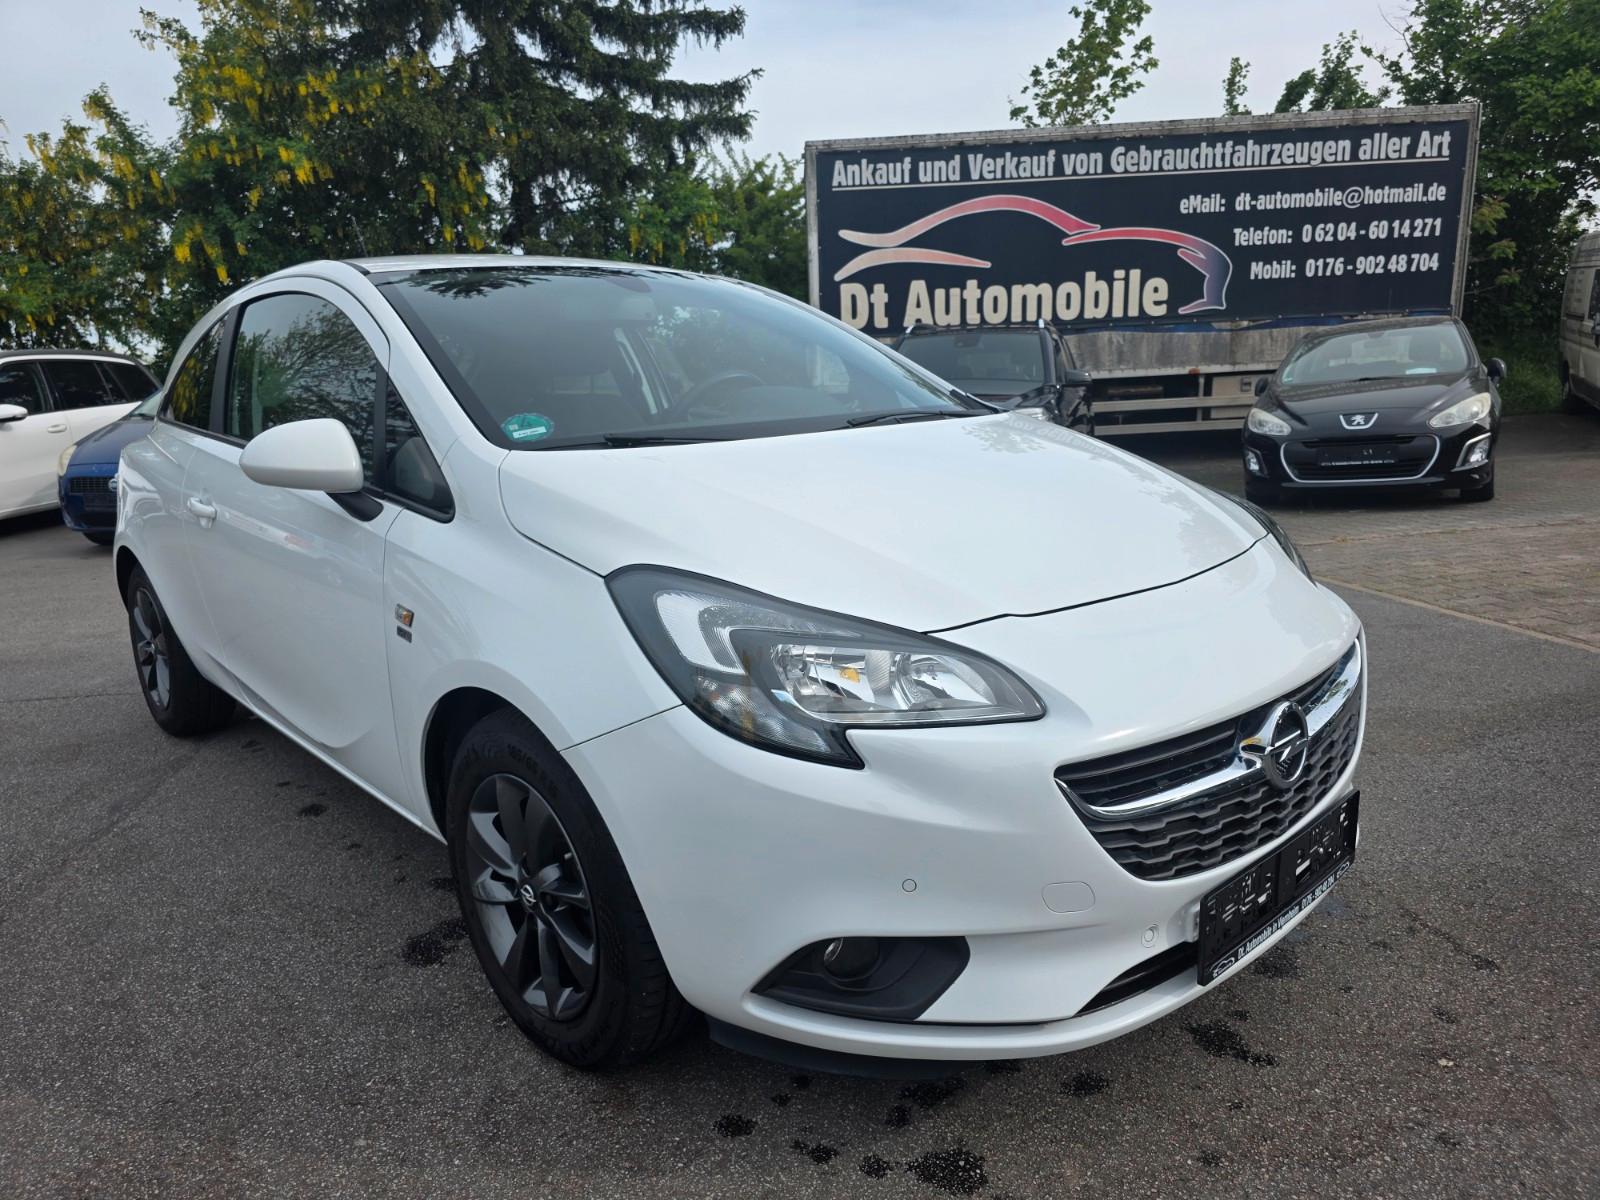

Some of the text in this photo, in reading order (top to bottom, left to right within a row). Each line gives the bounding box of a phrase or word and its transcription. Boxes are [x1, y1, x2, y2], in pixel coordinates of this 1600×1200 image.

[832, 130, 1451, 187] Ankauf und Verkauf von Gebrauchtfahrzeugen aller Art
[1179, 182, 1447, 214] eMail: dt-automobile@hotmail.de
[1233, 226, 1293, 246] Telefon:
[1250, 260, 1297, 280] Mobil:
[840, 268, 1169, 330] Dt Automobile
